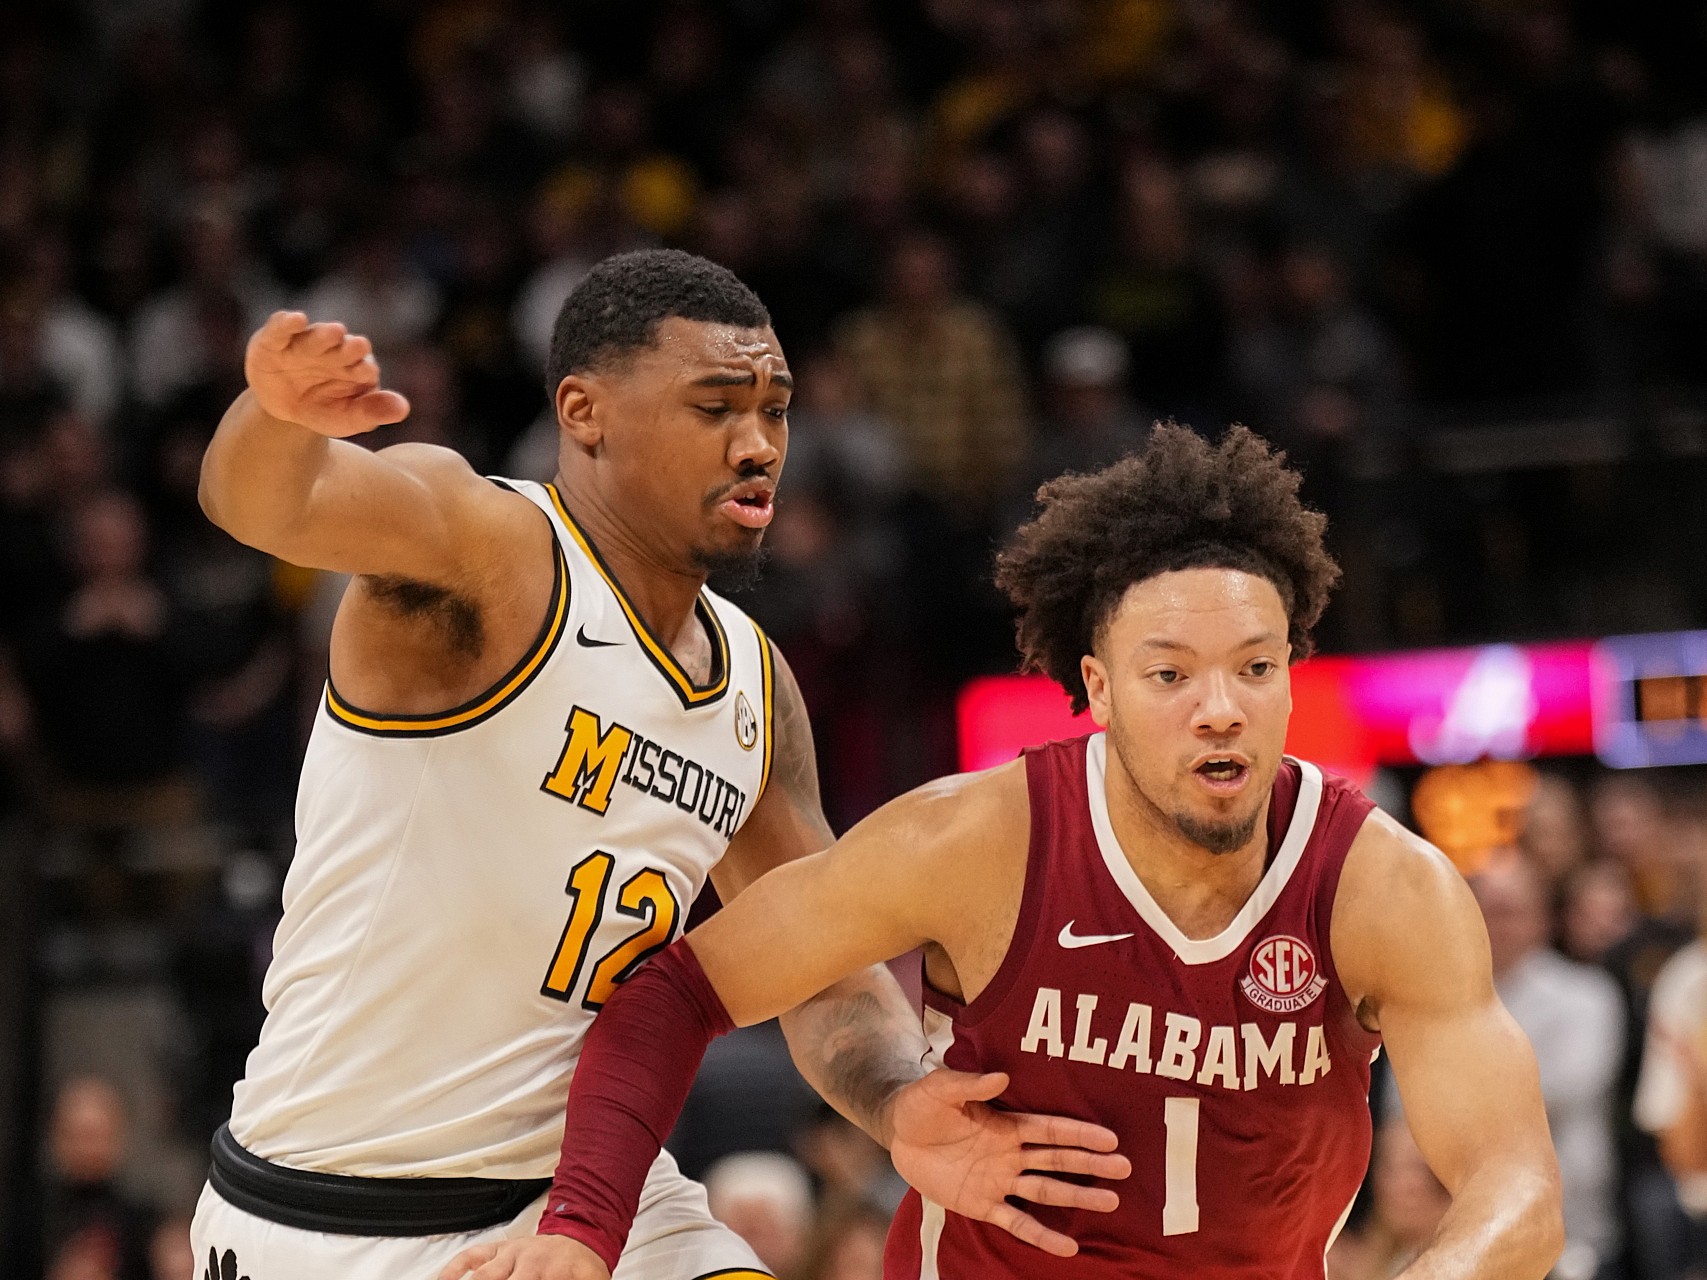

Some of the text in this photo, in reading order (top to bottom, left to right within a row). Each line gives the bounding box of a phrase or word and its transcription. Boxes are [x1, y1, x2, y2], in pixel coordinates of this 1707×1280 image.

[540, 849, 681, 1012] 12
[1255, 940, 1309, 993] SEC
[1020, 987, 1332, 1092] ALABAMA
[1248, 988, 1317, 1012] GRADUATE
[1162, 1096, 1200, 1237] 1
